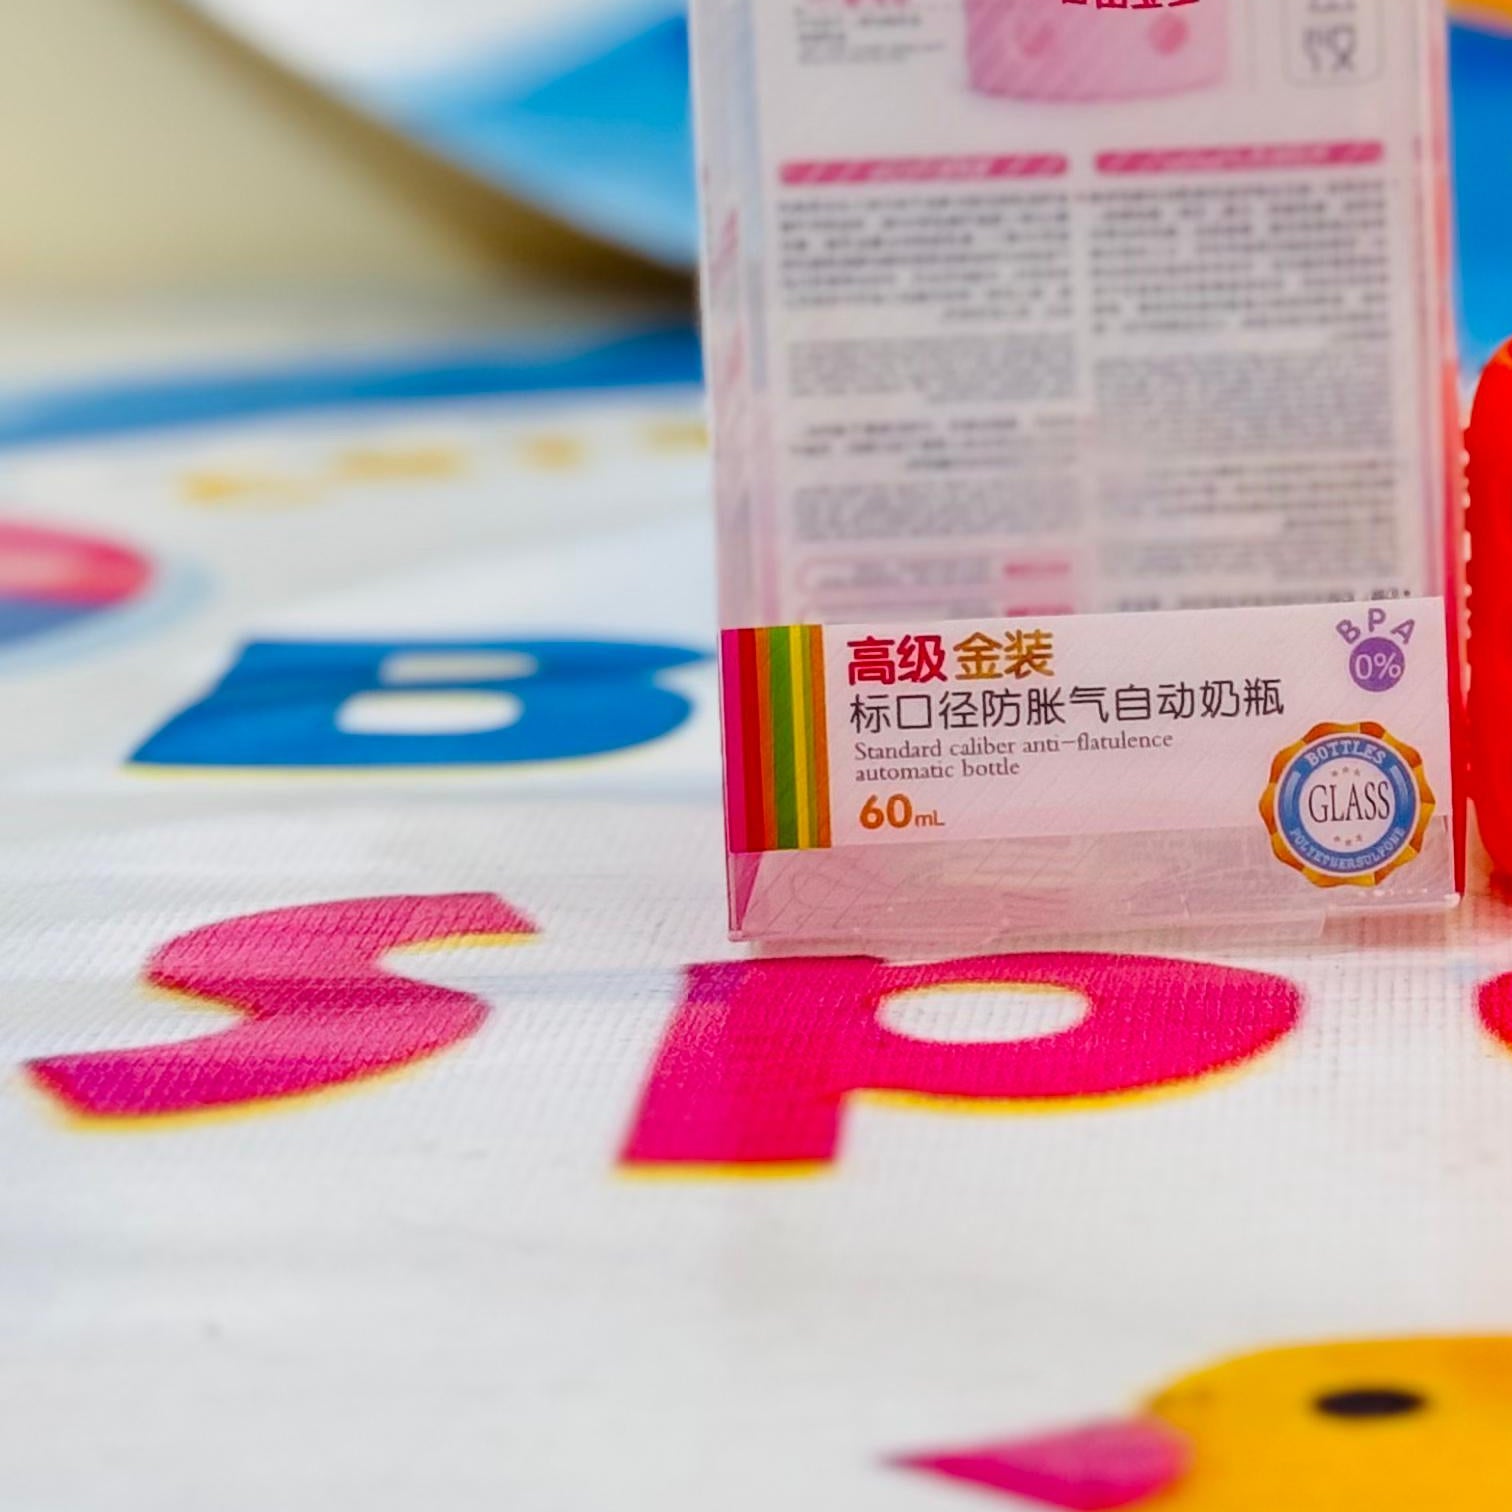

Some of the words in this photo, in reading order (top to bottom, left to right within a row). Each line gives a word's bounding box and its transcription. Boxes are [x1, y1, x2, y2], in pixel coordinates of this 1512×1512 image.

[1335, 607, 1416, 645] BPA
[847, 634, 948, 686] 高级
[952, 628, 1055, 682] 金装
[1354, 652, 1401, 681] 0%
[849, 676, 1285, 734] 标口径防胀气自动奶瓶
[854, 737, 942, 761] Standard
[949, 736, 1015, 758] caliber
[1304, 738, 1388, 768] BOTTLES
[854, 760, 955, 782] automatic
[961, 758, 1020, 777] bottle
[1308, 780, 1392, 824] GLASS
